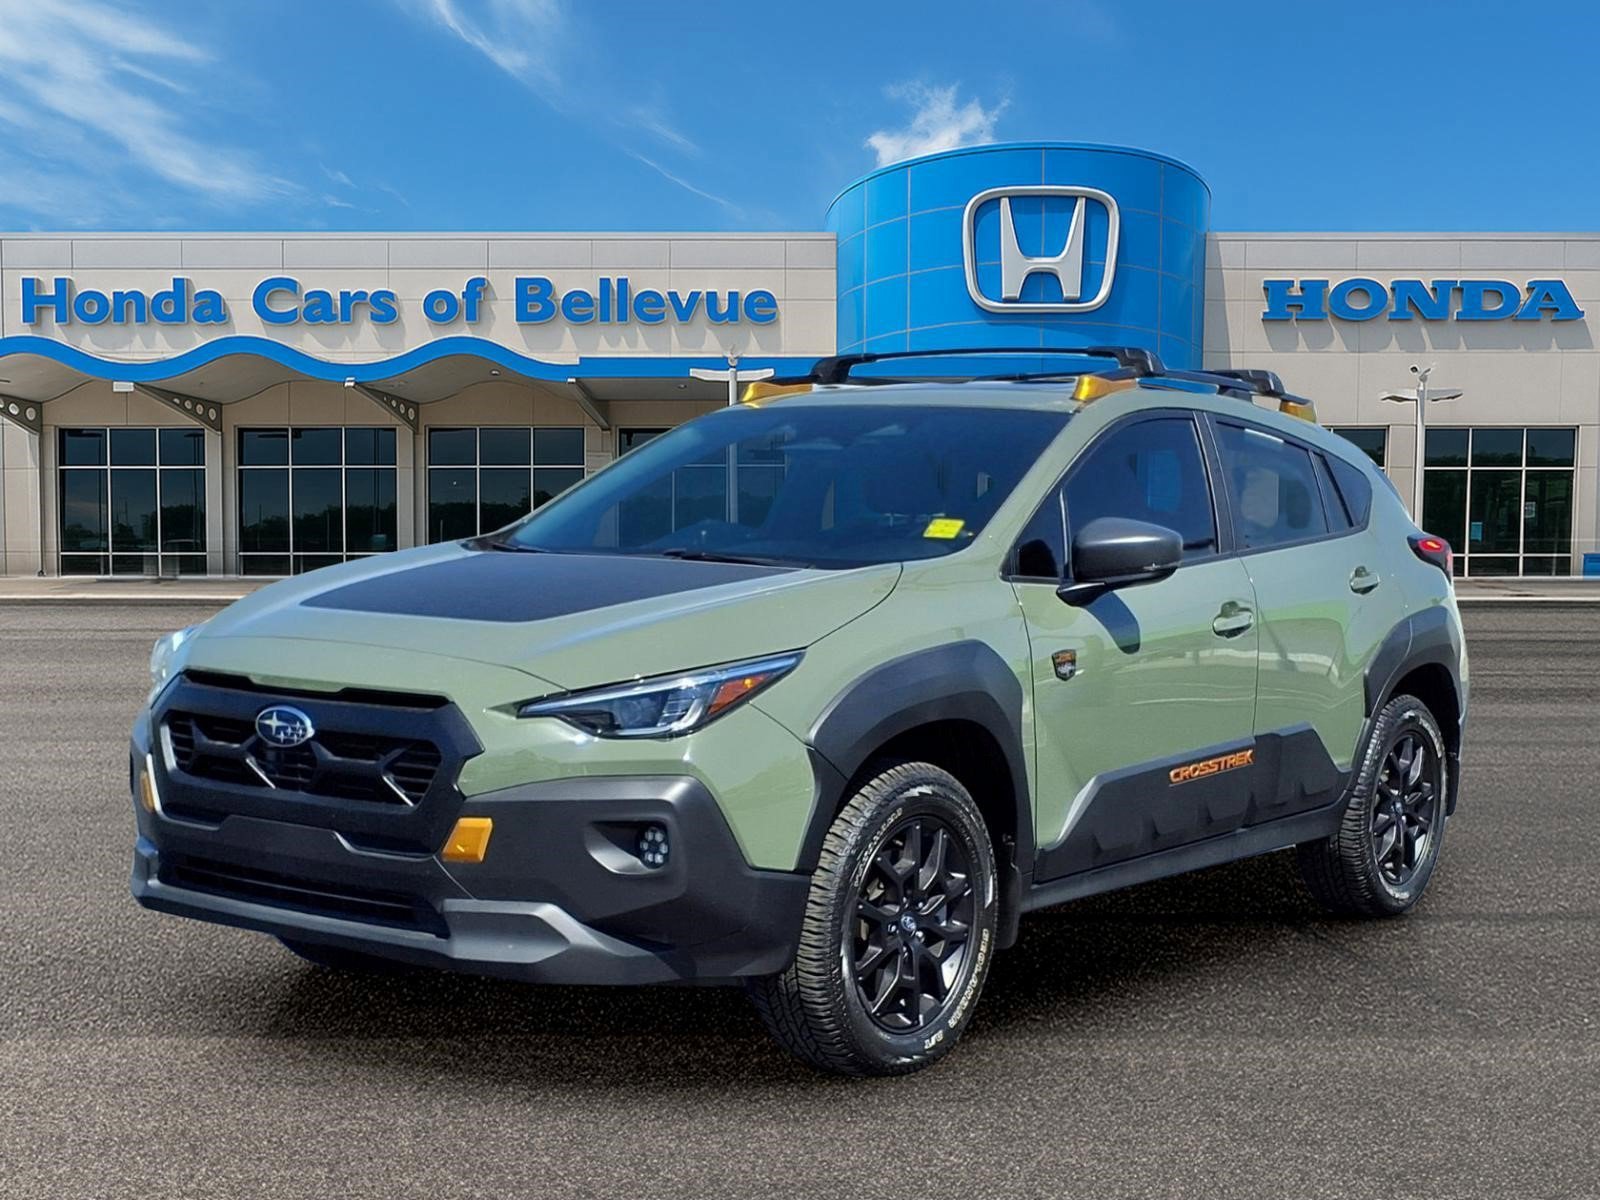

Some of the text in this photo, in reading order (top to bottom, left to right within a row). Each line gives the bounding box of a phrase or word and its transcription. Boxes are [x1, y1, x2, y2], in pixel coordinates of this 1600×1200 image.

[20, 275, 779, 325] Honda Cars of Bellevue
[1262, 277, 1585, 321] HONDA
[1169, 749, 1254, 785] CROSSTREK
